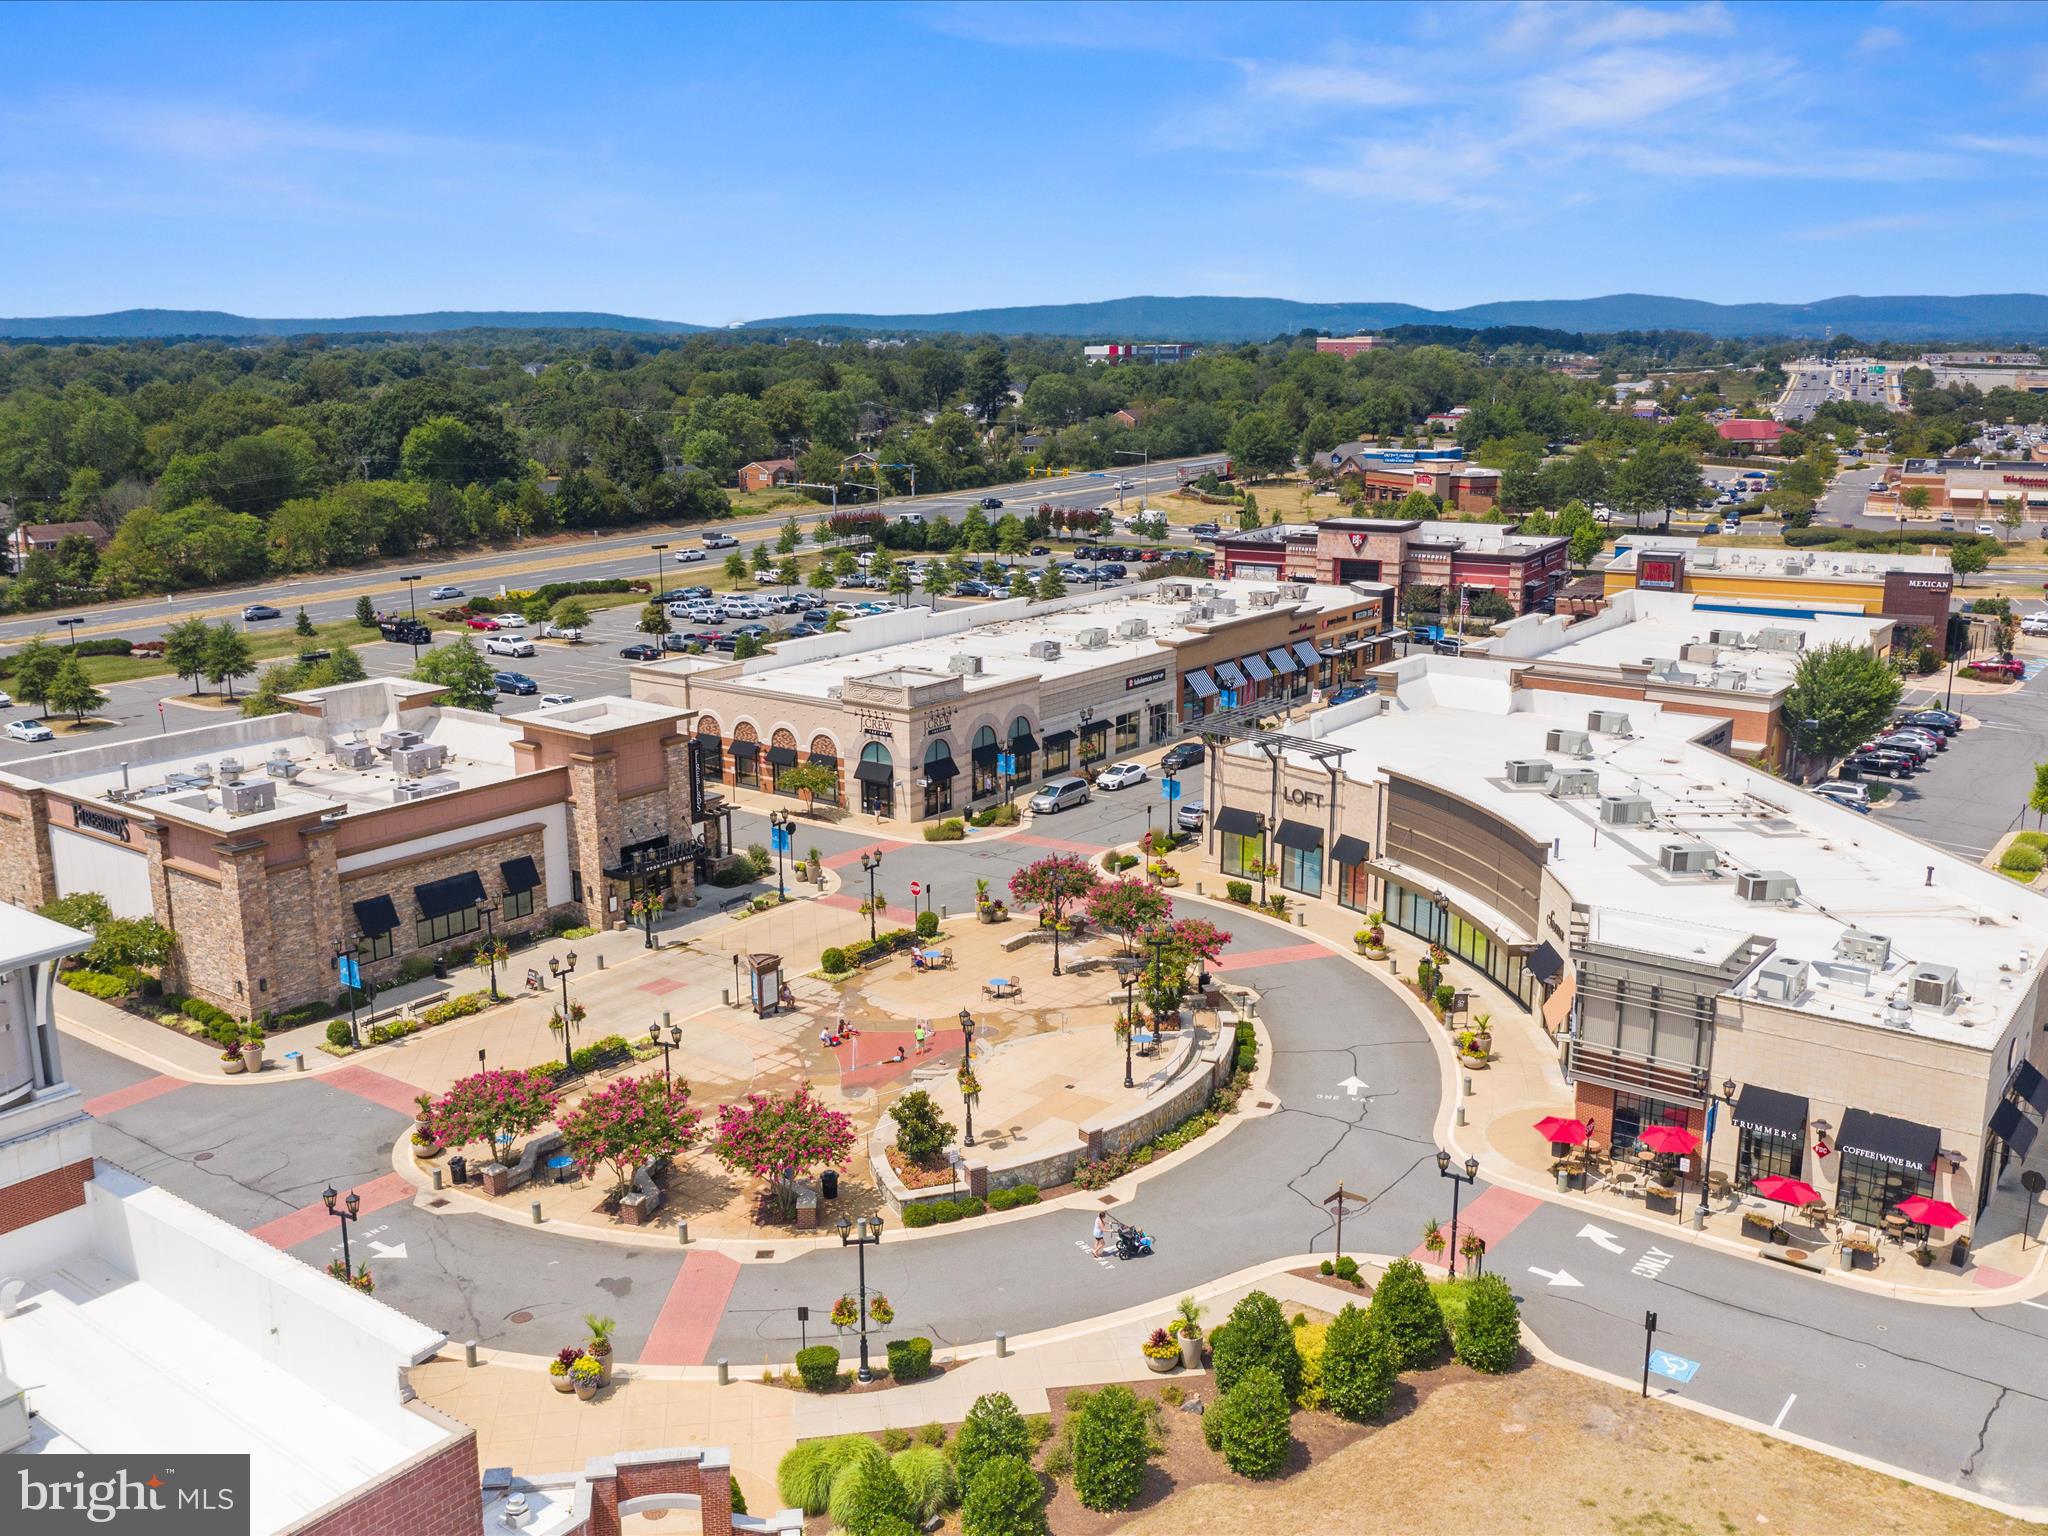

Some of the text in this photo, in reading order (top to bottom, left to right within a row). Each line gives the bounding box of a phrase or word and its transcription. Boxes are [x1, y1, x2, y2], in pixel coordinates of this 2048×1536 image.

[1908, 580, 1949, 588] MEXICAN
[1284, 786, 1324, 808] LOFT
[1732, 1118, 1797, 1141] TRUMMER'S
[1905, 1160, 1923, 1171] BAR
[1630, 1246, 1675, 1279] ONLY
